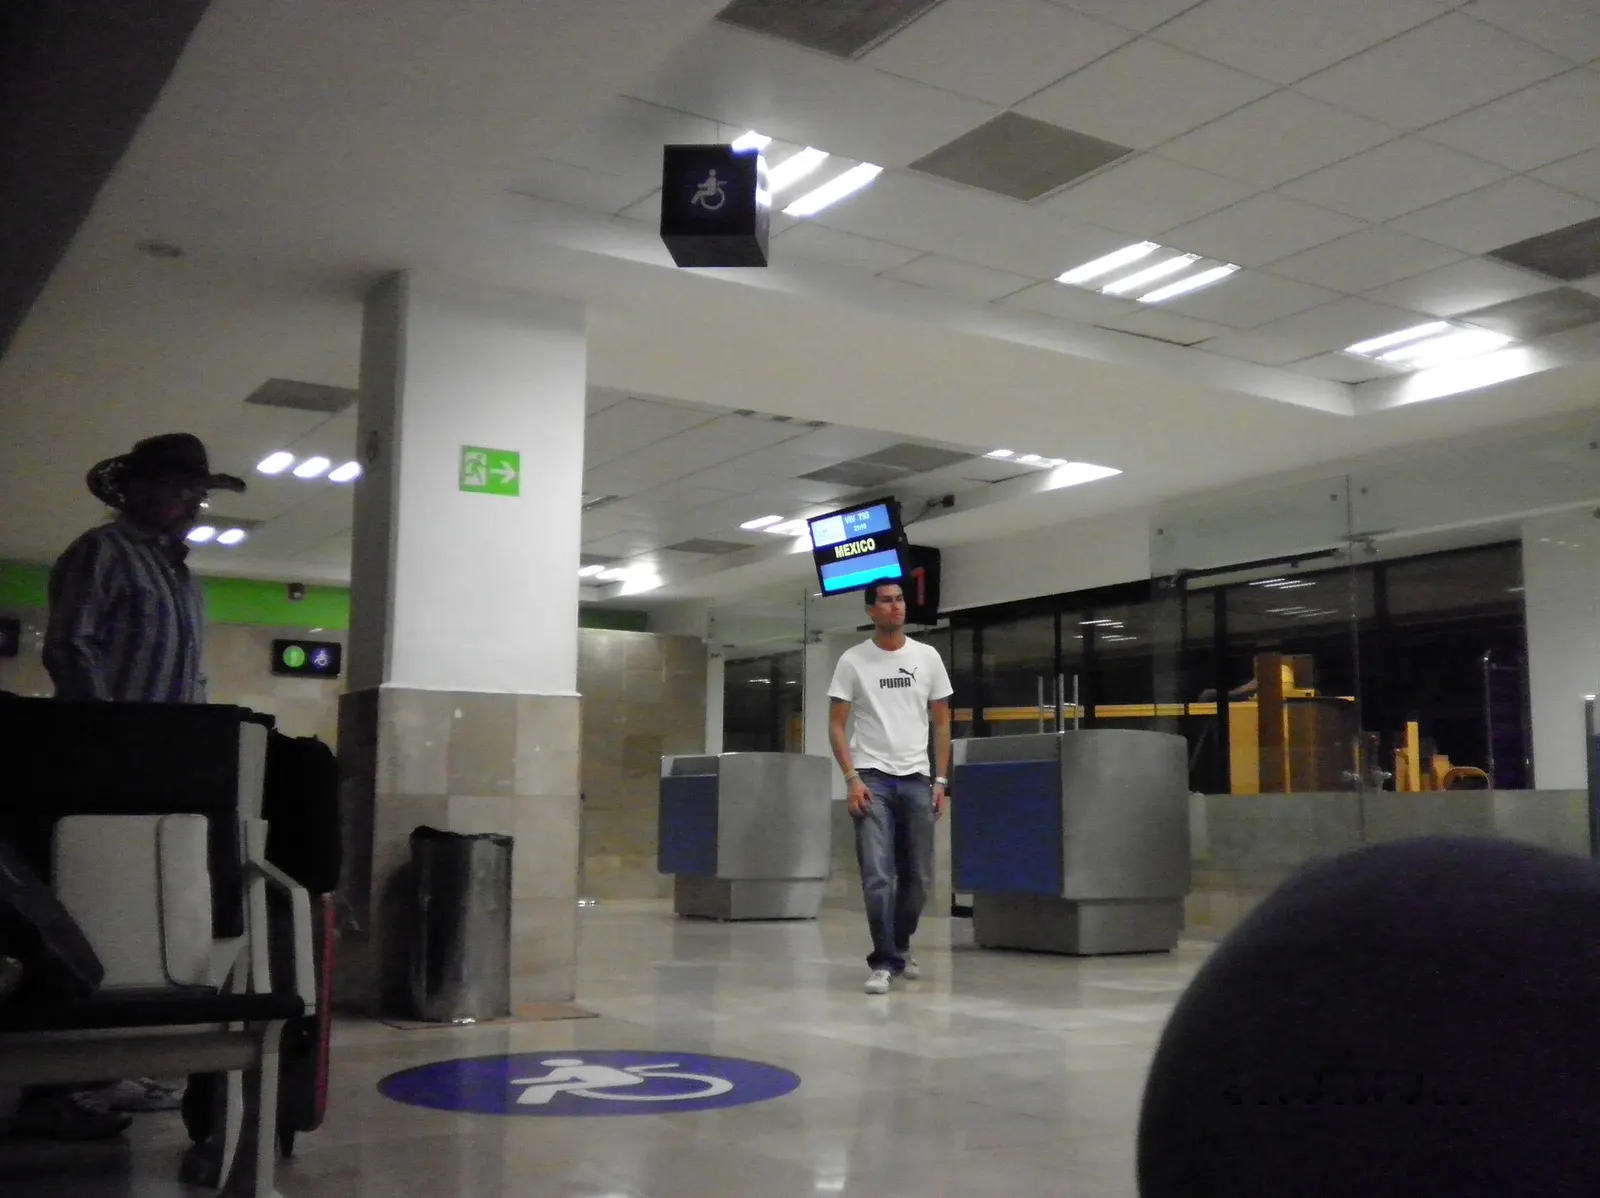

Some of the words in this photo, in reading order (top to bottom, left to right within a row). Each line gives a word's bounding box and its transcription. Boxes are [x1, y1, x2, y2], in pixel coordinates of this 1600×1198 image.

[834, 538, 876, 559] MEXICO
[911, 566, 925, 606] 1
[879, 677, 912, 689] PUMA
